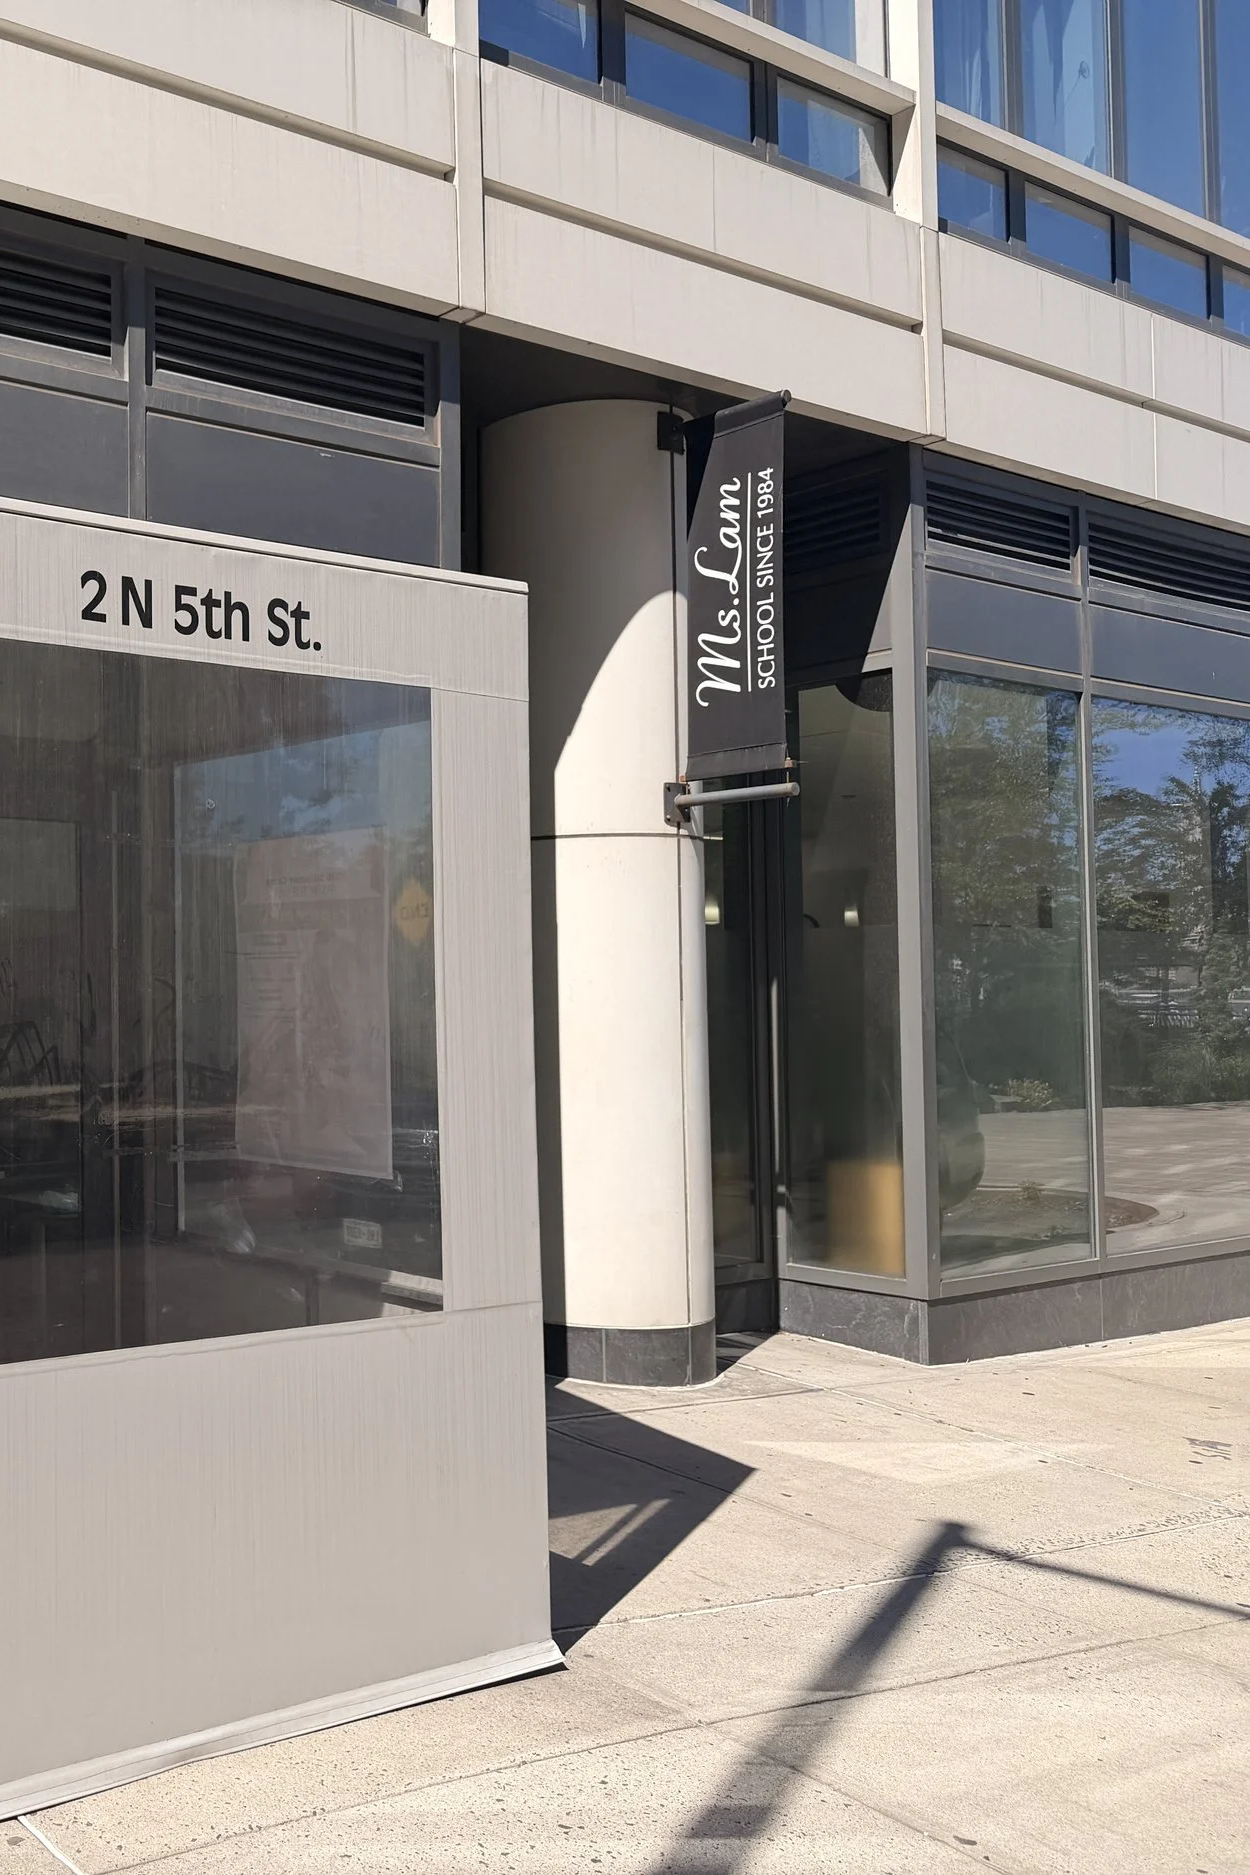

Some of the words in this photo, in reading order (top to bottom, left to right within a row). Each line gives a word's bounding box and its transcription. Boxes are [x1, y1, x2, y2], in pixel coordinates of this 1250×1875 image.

[757, 466, 774, 519] 1984
[756, 522, 775, 588] SINCE
[80, 570, 107, 623] 2
[121, 575, 153, 629] N
[174, 584, 250, 642] 5th
[266, 598, 322, 651] St.
[756, 591, 776, 690] SCHOOL
